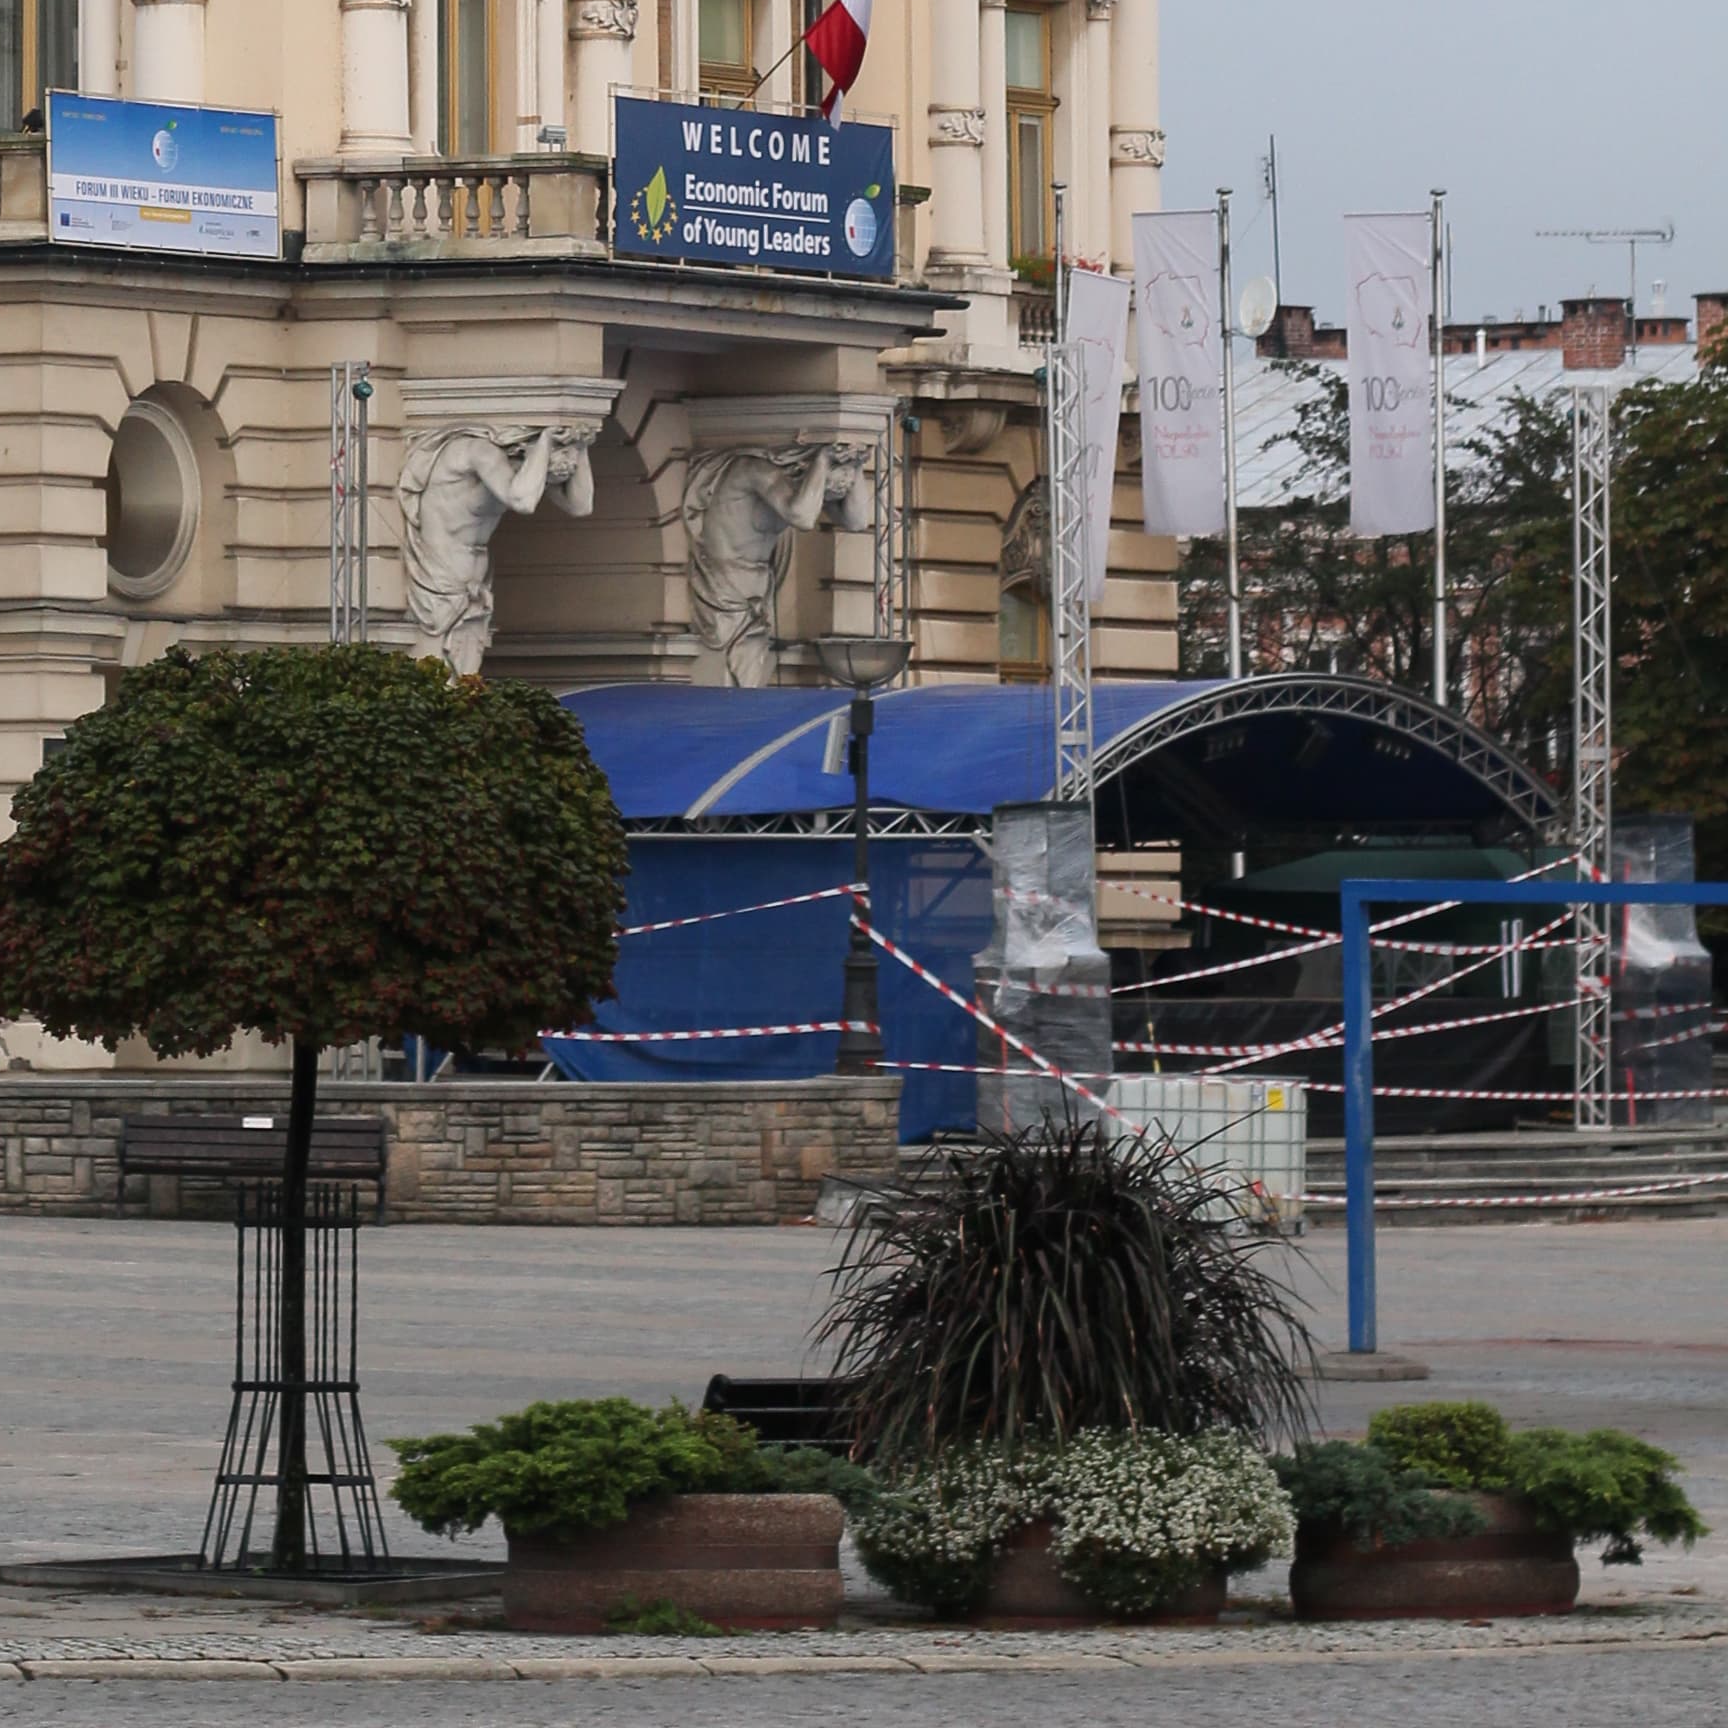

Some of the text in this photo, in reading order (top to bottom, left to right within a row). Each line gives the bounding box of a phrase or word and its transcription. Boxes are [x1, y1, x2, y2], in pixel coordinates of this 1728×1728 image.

[682, 120, 831, 166] WELCOME
[75, 180, 107, 198] FORUM
[109, 184, 119, 199] III
[120, 186, 149, 201] WIEKU
[158, 188, 190, 204] FORUM
[192, 191, 254, 211] EKONOMICZNE
[685, 173, 829, 214] Economic Forum
[682, 216, 831, 256] of Young Leaders
